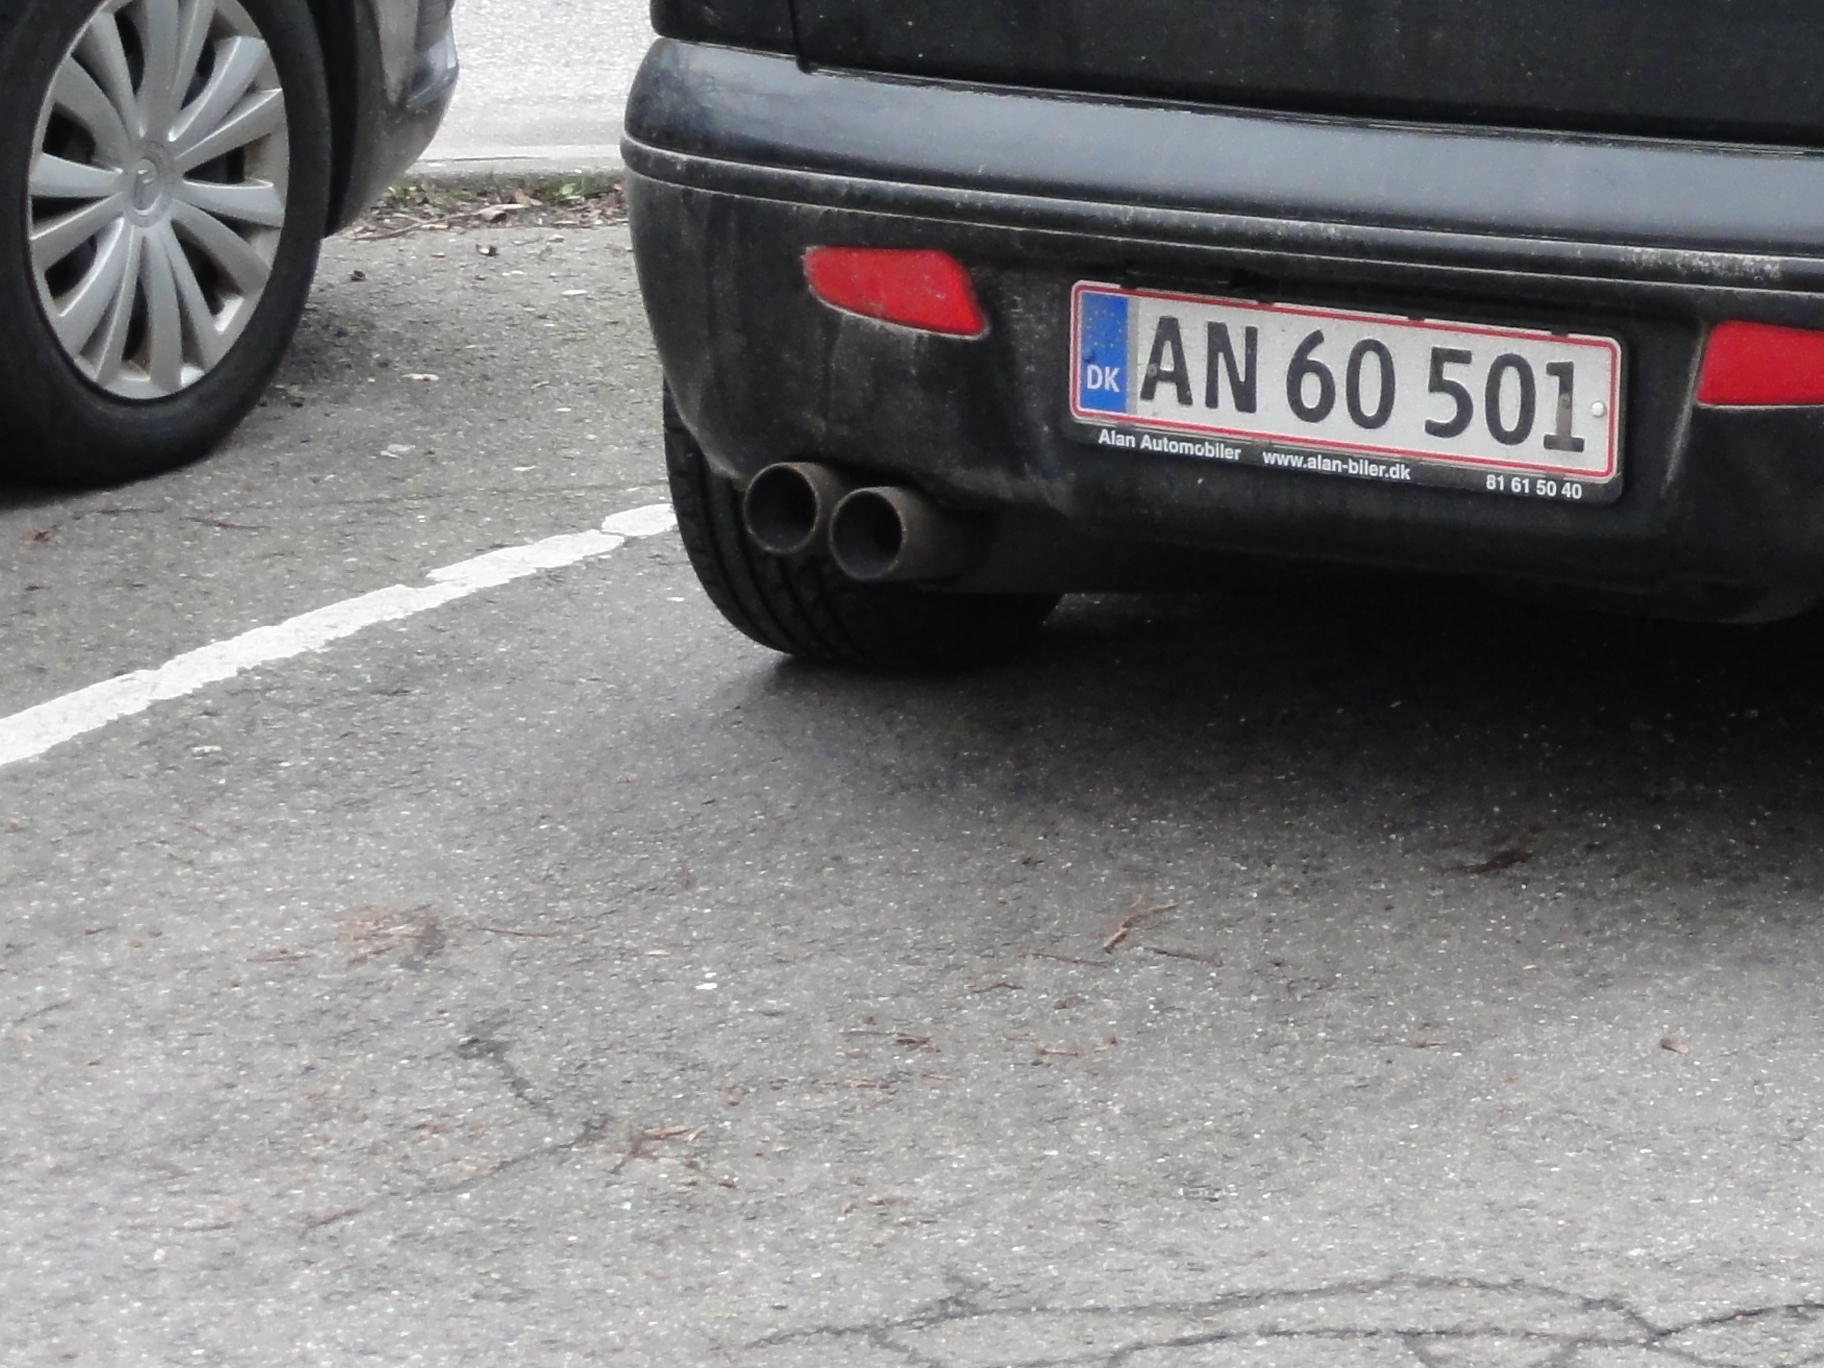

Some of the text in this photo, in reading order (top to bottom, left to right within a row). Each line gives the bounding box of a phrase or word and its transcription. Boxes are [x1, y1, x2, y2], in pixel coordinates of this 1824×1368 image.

[1086, 364, 1120, 392] DK
[1140, 315, 1585, 453] AN 60 501
[1098, 429, 1412, 480] Alan Automobiler www.alan-biler.dk
[1486, 474, 1582, 500] 81 61 50 40
